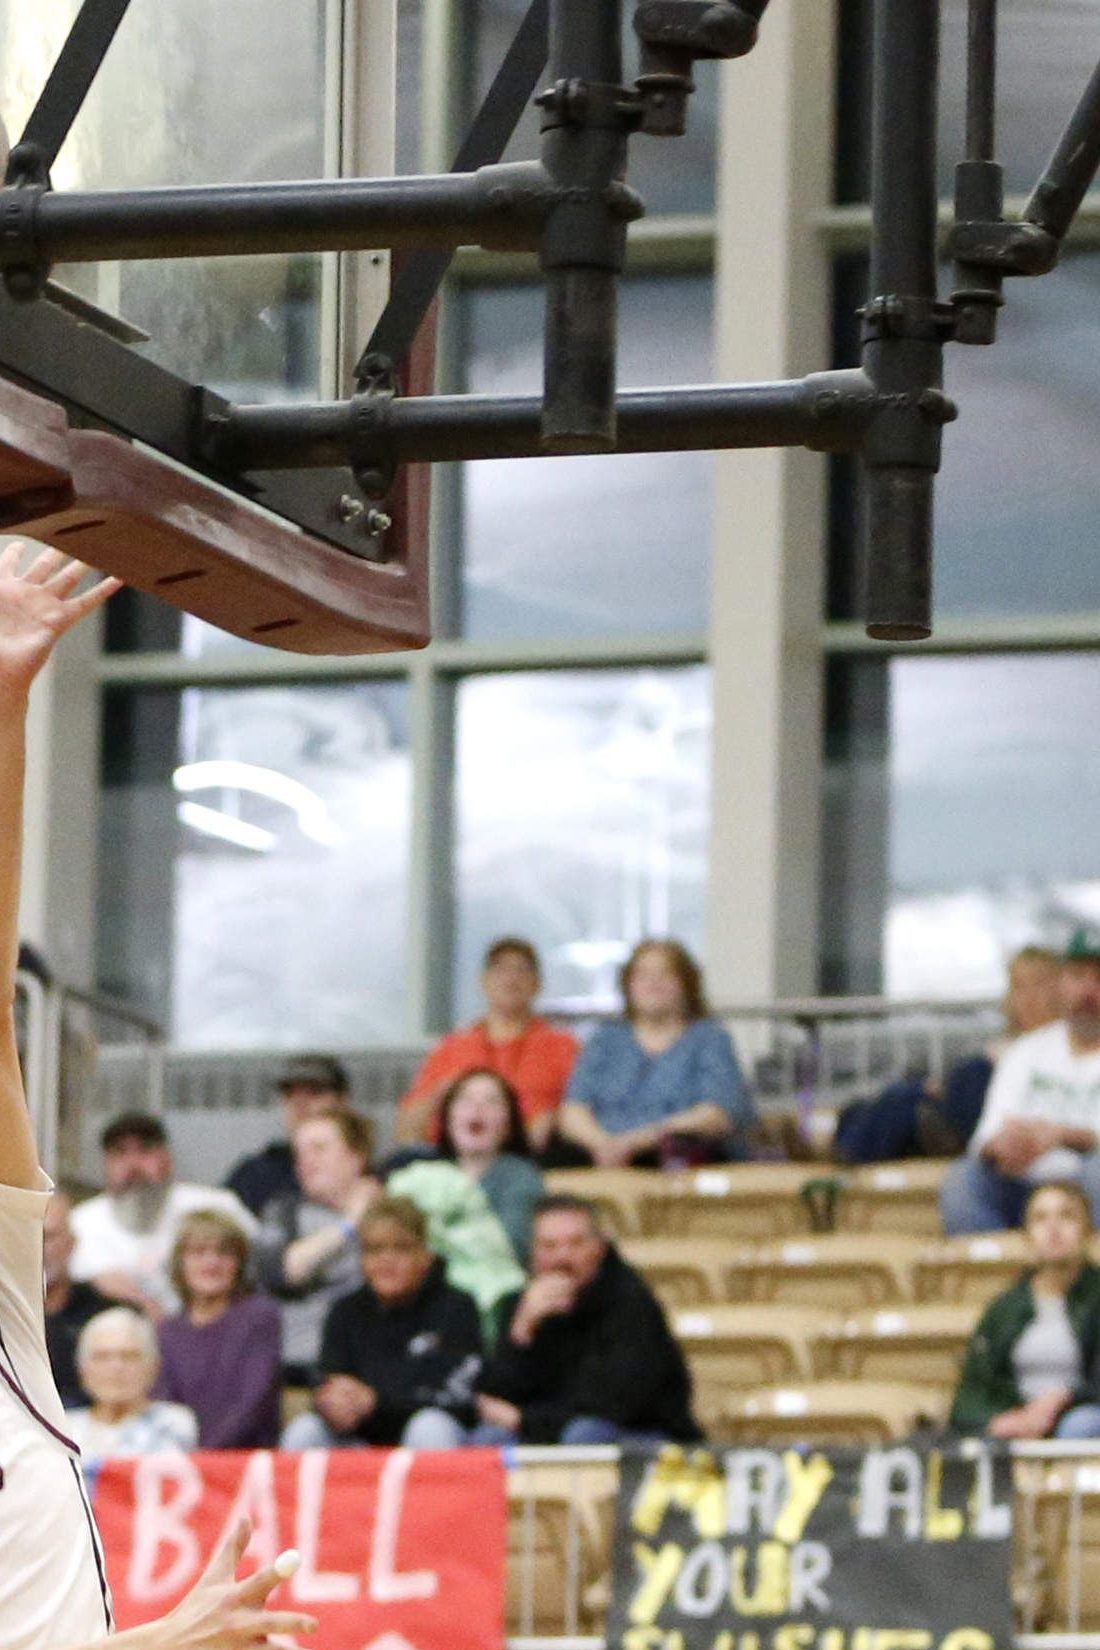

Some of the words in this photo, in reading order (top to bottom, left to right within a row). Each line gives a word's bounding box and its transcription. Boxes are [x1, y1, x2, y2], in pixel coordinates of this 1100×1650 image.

[128, 1449, 440, 1602] BALL
[631, 1444, 834, 1542] MAY
[856, 1446, 1013, 1541] ALL
[628, 1539, 833, 1625] YOUR
